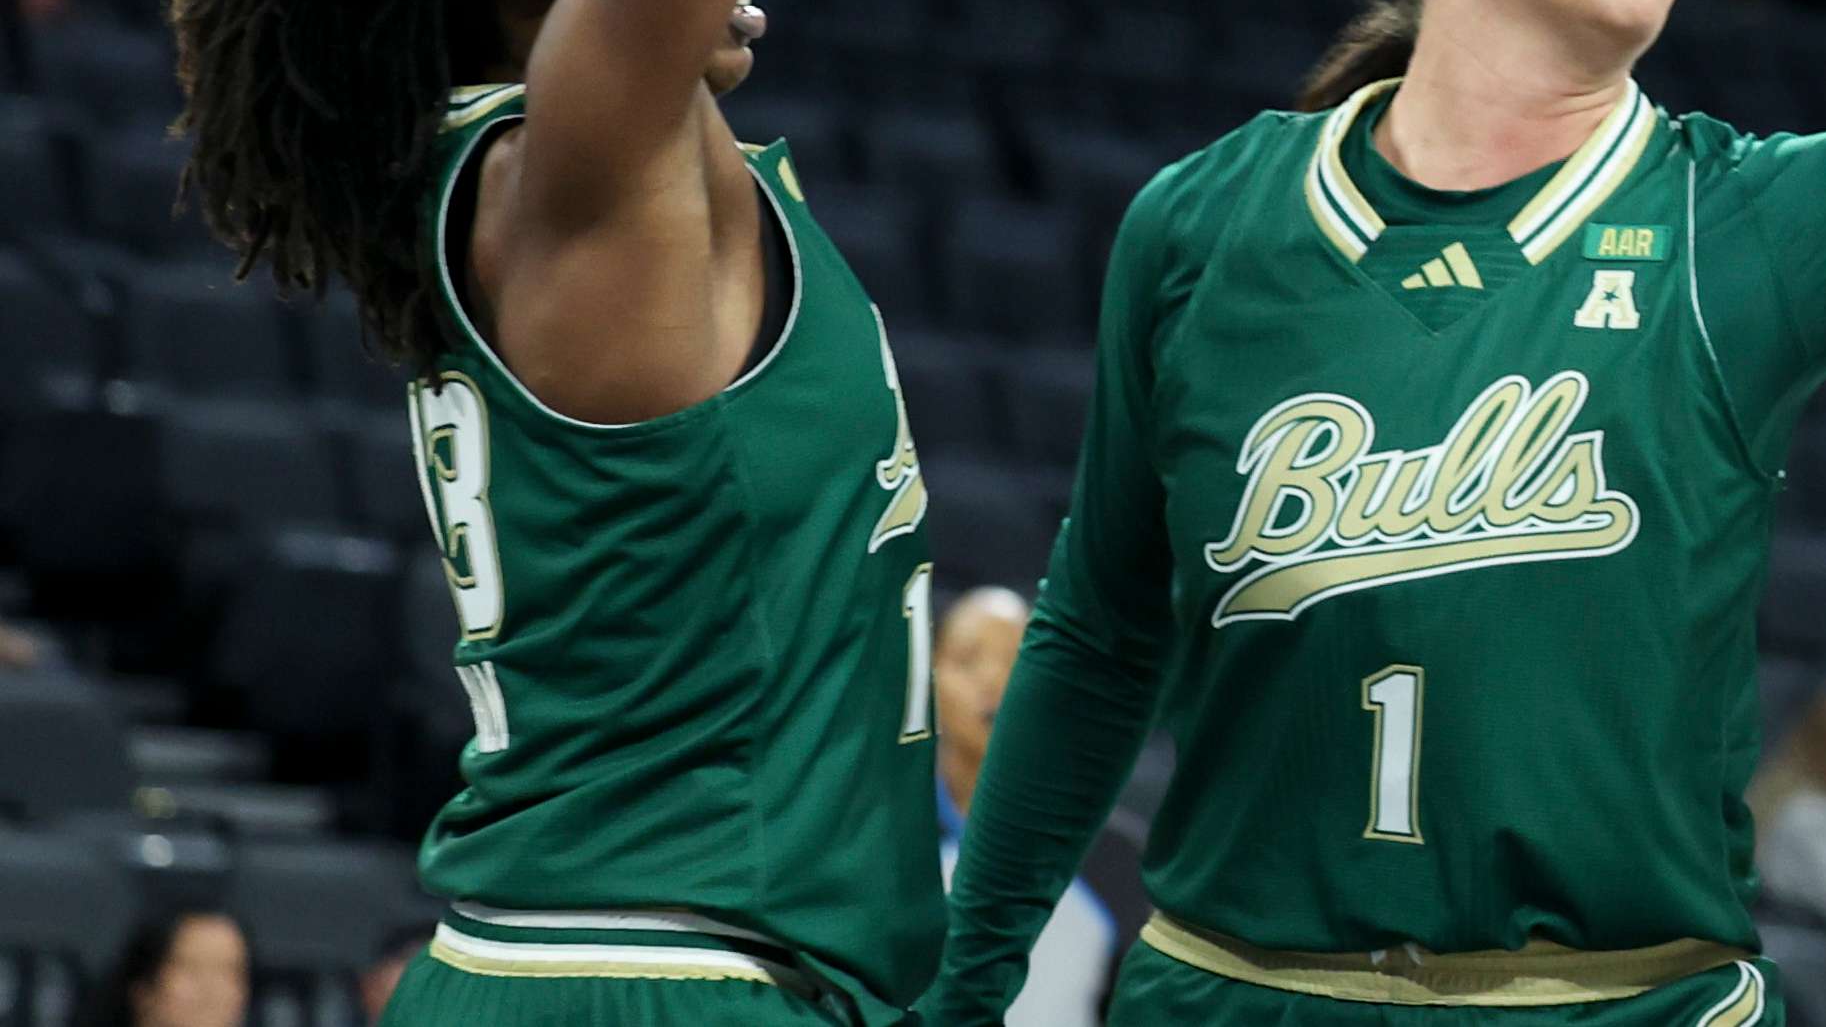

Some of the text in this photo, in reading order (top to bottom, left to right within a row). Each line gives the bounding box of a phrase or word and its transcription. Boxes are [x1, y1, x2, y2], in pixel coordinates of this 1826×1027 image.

[1573, 270, 1640, 330] A
[1598, 227, 1654, 257] AAR
[1205, 371, 1640, 628] Bulls
[1362, 664, 1425, 845] 1
